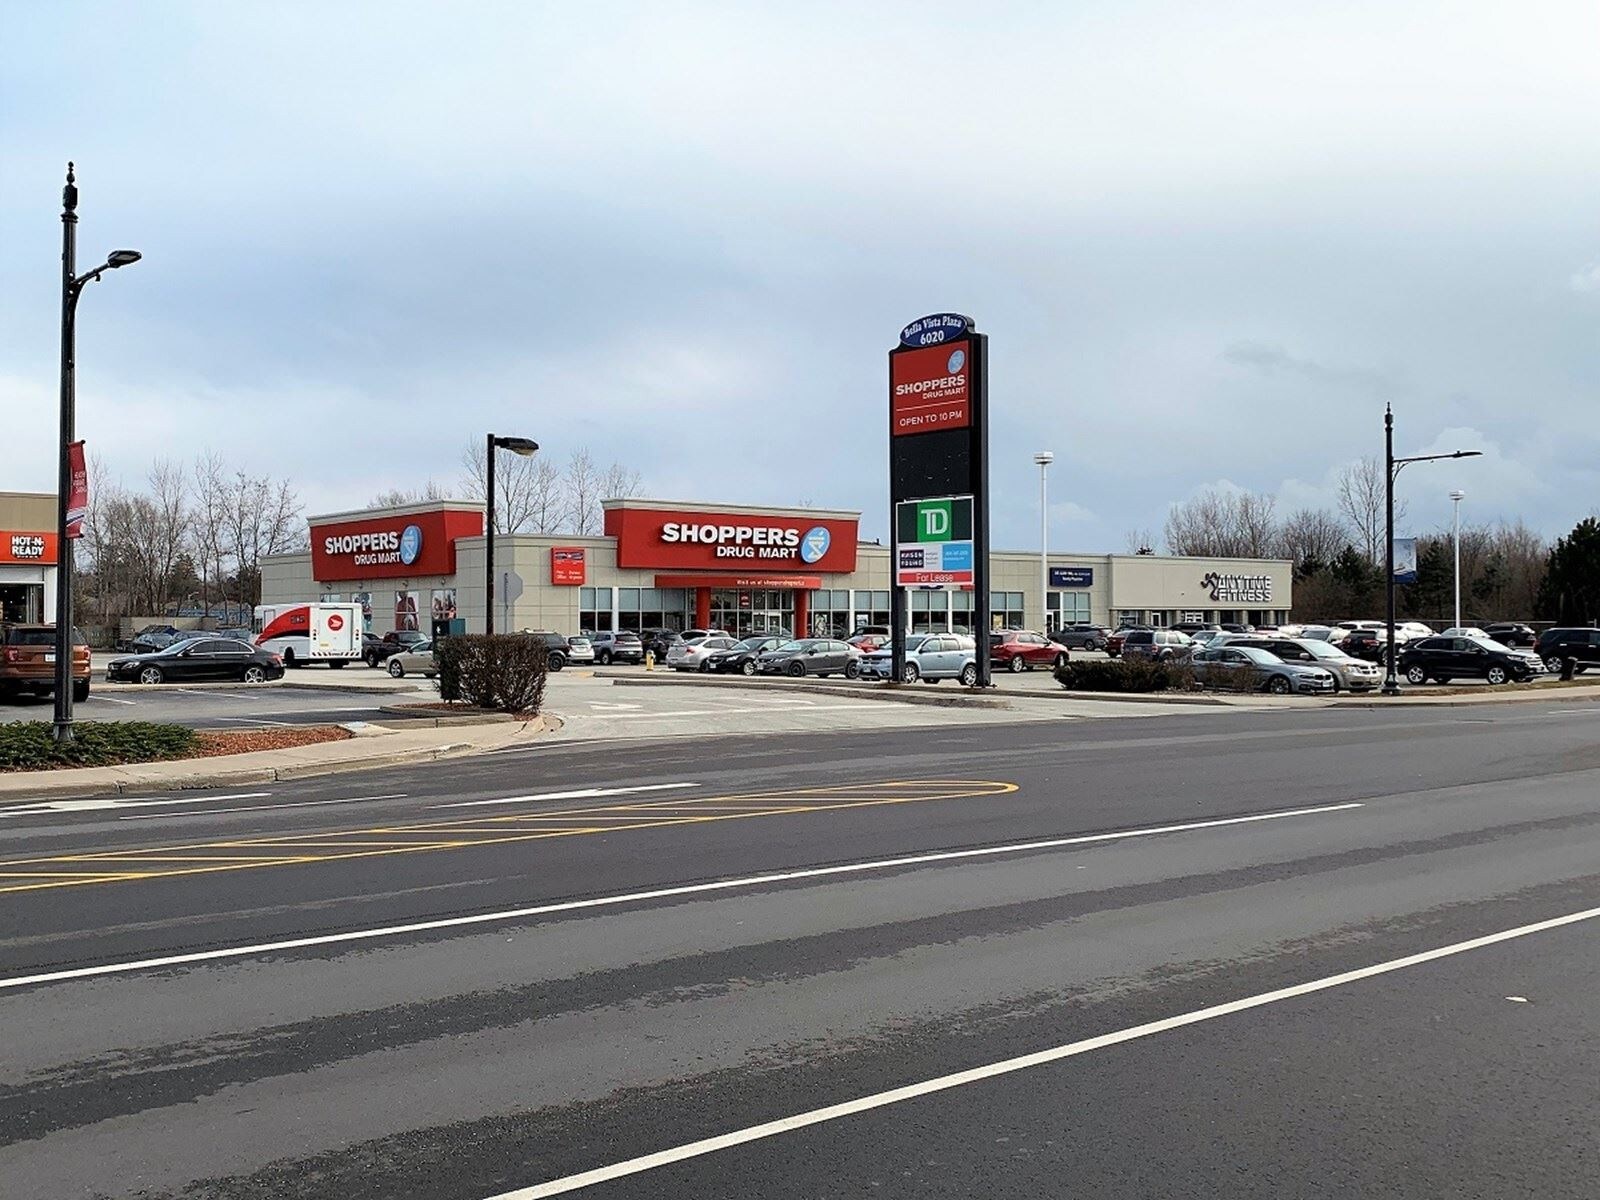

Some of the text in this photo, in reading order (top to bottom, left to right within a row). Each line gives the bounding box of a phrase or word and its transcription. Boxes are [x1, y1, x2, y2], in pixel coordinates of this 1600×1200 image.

[904, 316, 962, 338] Bella Vista Plaza
[920, 330, 945, 345] 6020
[896, 375, 965, 395] SHOPPERS
[922, 386, 966, 400] DRUG MART
[899, 410, 962, 427] OPEN TO 10 PM
[921, 508, 949, 535] TD
[11, 535, 45, 546] HOT-N-
[661, 523, 800, 546] SHOPPERS
[325, 531, 399, 554] SHOPPERS
[11, 546, 45, 556] READY
[354, 551, 401, 565] DRUG MART
[716, 546, 798, 559] DRUG MART
[915, 572, 954, 582] For Lease
[1218, 574, 1272, 589] ANYTIME
[1219, 589, 1272, 601] FITNESS
